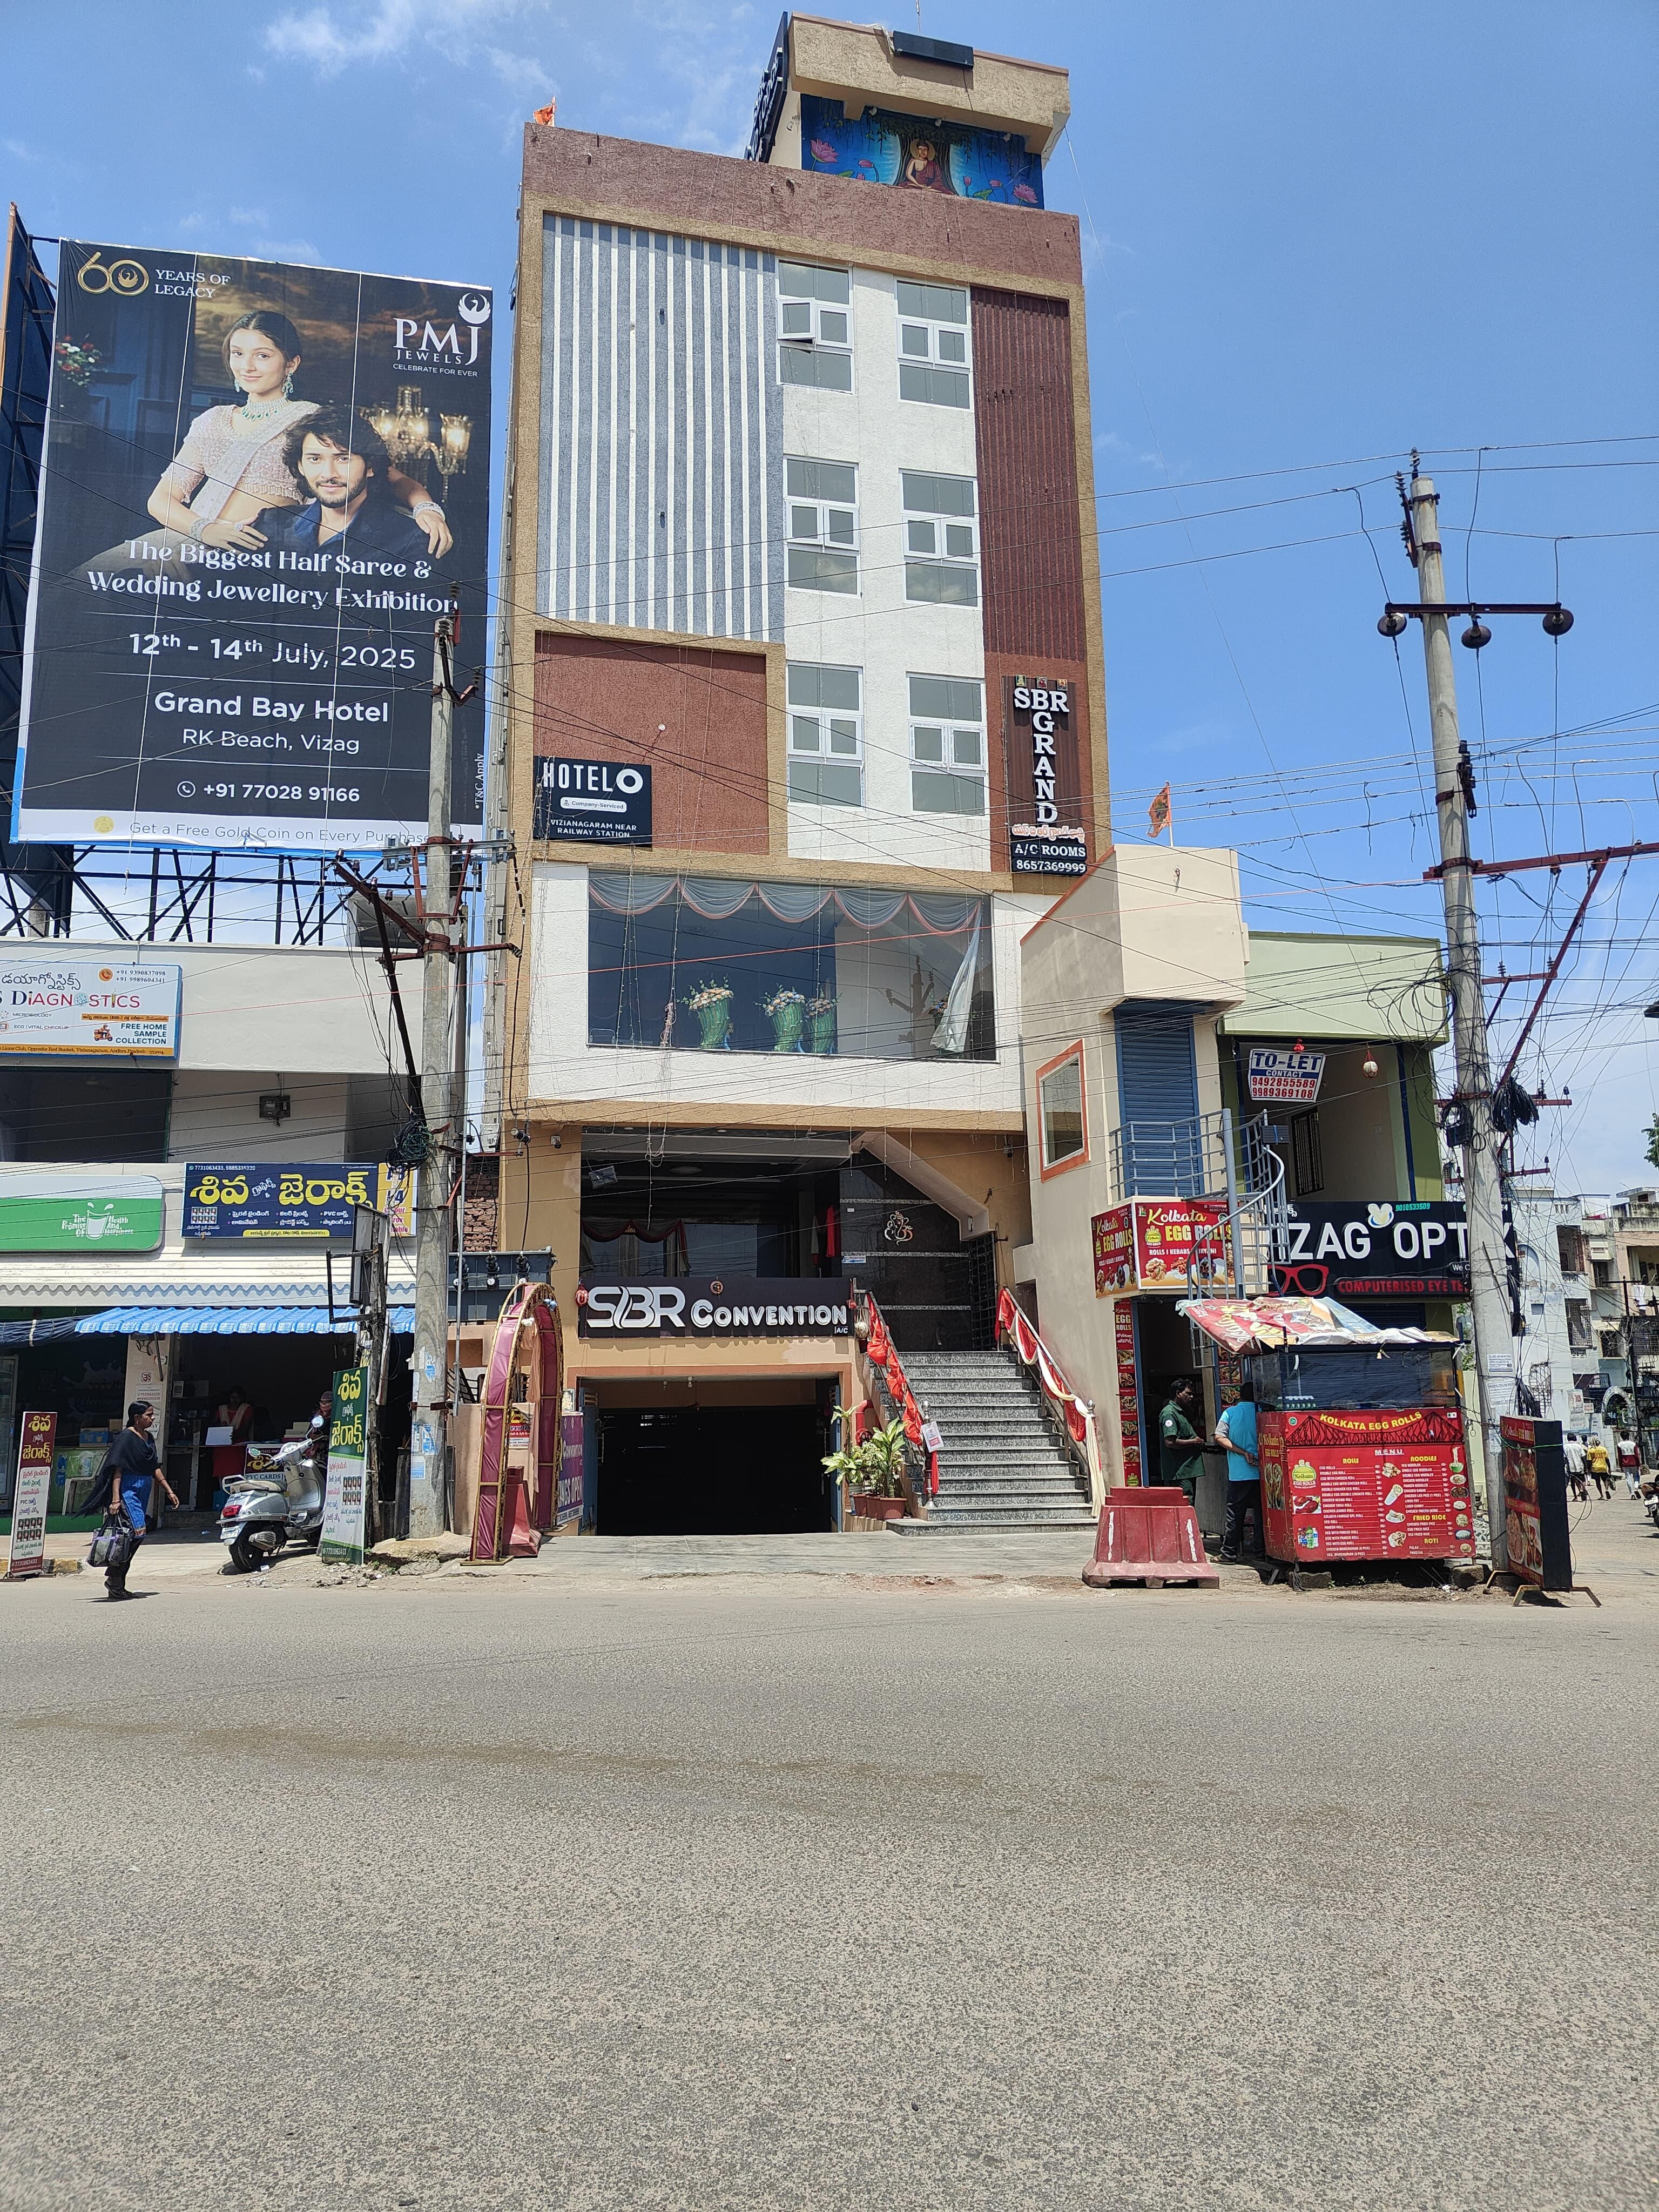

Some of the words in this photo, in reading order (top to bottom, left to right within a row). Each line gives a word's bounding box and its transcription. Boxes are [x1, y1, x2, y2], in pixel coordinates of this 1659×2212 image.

[78, 252, 149, 296] 60
[156, 269, 205, 282] YEARS
[210, 274, 231, 285] OF
[155, 284, 216, 298] LEGACY
[393, 318, 482, 366] PMJ
[396, 349, 461, 365] JEWELS
[393, 363, 437, 373] CELEBRATE
[125, 540, 172, 561] The
[180, 543, 272, 570] Biggest
[279, 551, 332, 572] Half
[335, 555, 407, 577] Saree
[414, 561, 431, 578] &
[87, 571, 201, 602] Wedding
[207, 579, 329, 610] Jewellery
[335, 588, 457, 613] Exhibition
[130, 633, 181, 656] 12th
[210, 638, 263, 660] 14th
[272, 642, 329, 670] July,
[341, 646, 415, 670] 2025
[155, 692, 241, 716] Grand
[253, 697, 305, 722] Bay
[315, 700, 389, 722] Hotel
[1014, 687, 1070, 713] SBR
[183, 729, 214, 746] RK
[221, 730, 293, 751] Beach,
[301, 734, 360, 754] Vizag
[1033, 711, 1058, 822] GRAND
[543, 762, 613, 792] HOTEL
[204, 783, 235, 798] +91
[242, 784, 302, 800] 77028
[308, 786, 360, 802] 91166
[571, 801, 624, 809] Company-Serviced
[130, 822, 157, 834] Get
[162, 825, 171, 834] a
[177, 824, 210, 836] Free
[215, 826, 251, 838] Gold
[257, 827, 289, 839] Coin
[295, 831, 314, 840] on
[320, 830, 360, 844] Every
[550, 819, 612, 829] VIZIANAGARAM
[557, 827, 593, 835] RAILWAY
[1015, 844, 1038, 855] A/C
[1041, 845, 1086, 857] ROOMS
[1016, 859, 1086, 873] 8657369999
[1254, 1053, 1321, 1070] TO-LET
[1252, 1077, 1316, 1088] 9492855589
[1252, 1088, 1313, 1098] 9989369108
[190, 1175, 249, 1204] శివ
[1395, 1203, 1430, 1211] 9010533509
[62, 1220, 86, 1230] Promise
[72, 1214, 86, 1223] The
[108, 1215, 129, 1223] Health
[1147, 1208, 1206, 1226] Kolkata
[1097, 1217, 1118, 1236] Kolkata
[1165, 1225, 1191, 1241] EGG
[1103, 1234, 1115, 1252] EGG
[1115, 1229, 1133, 1249] ROLLS
[1264, 1222, 1371, 1260] IZAG
[1393, 1222, 1516, 1260] OPTK
[1338, 1279, 1424, 1293] COMPUTERISED
[1428, 1279, 1448, 1292] EYE
[587, 1286, 686, 1329] SBR
[1116, 1314, 1131, 1323] EGG
[836, 1326, 849, 1334] A/C
[338, 1370, 361, 1401] శివ
[28, 1415, 51, 1432] శివ
[1320, 1414, 1366, 1430] KOLKATA
[1368, 1421, 1389, 1430] EGG
[1392, 1412, 1422, 1427] ROLLS
[332, 1414, 364, 1453] జెరాక్స్
[23, 1442, 51, 1463] జెరాక్స్
[571, 1475, 583, 1505] OPEN
